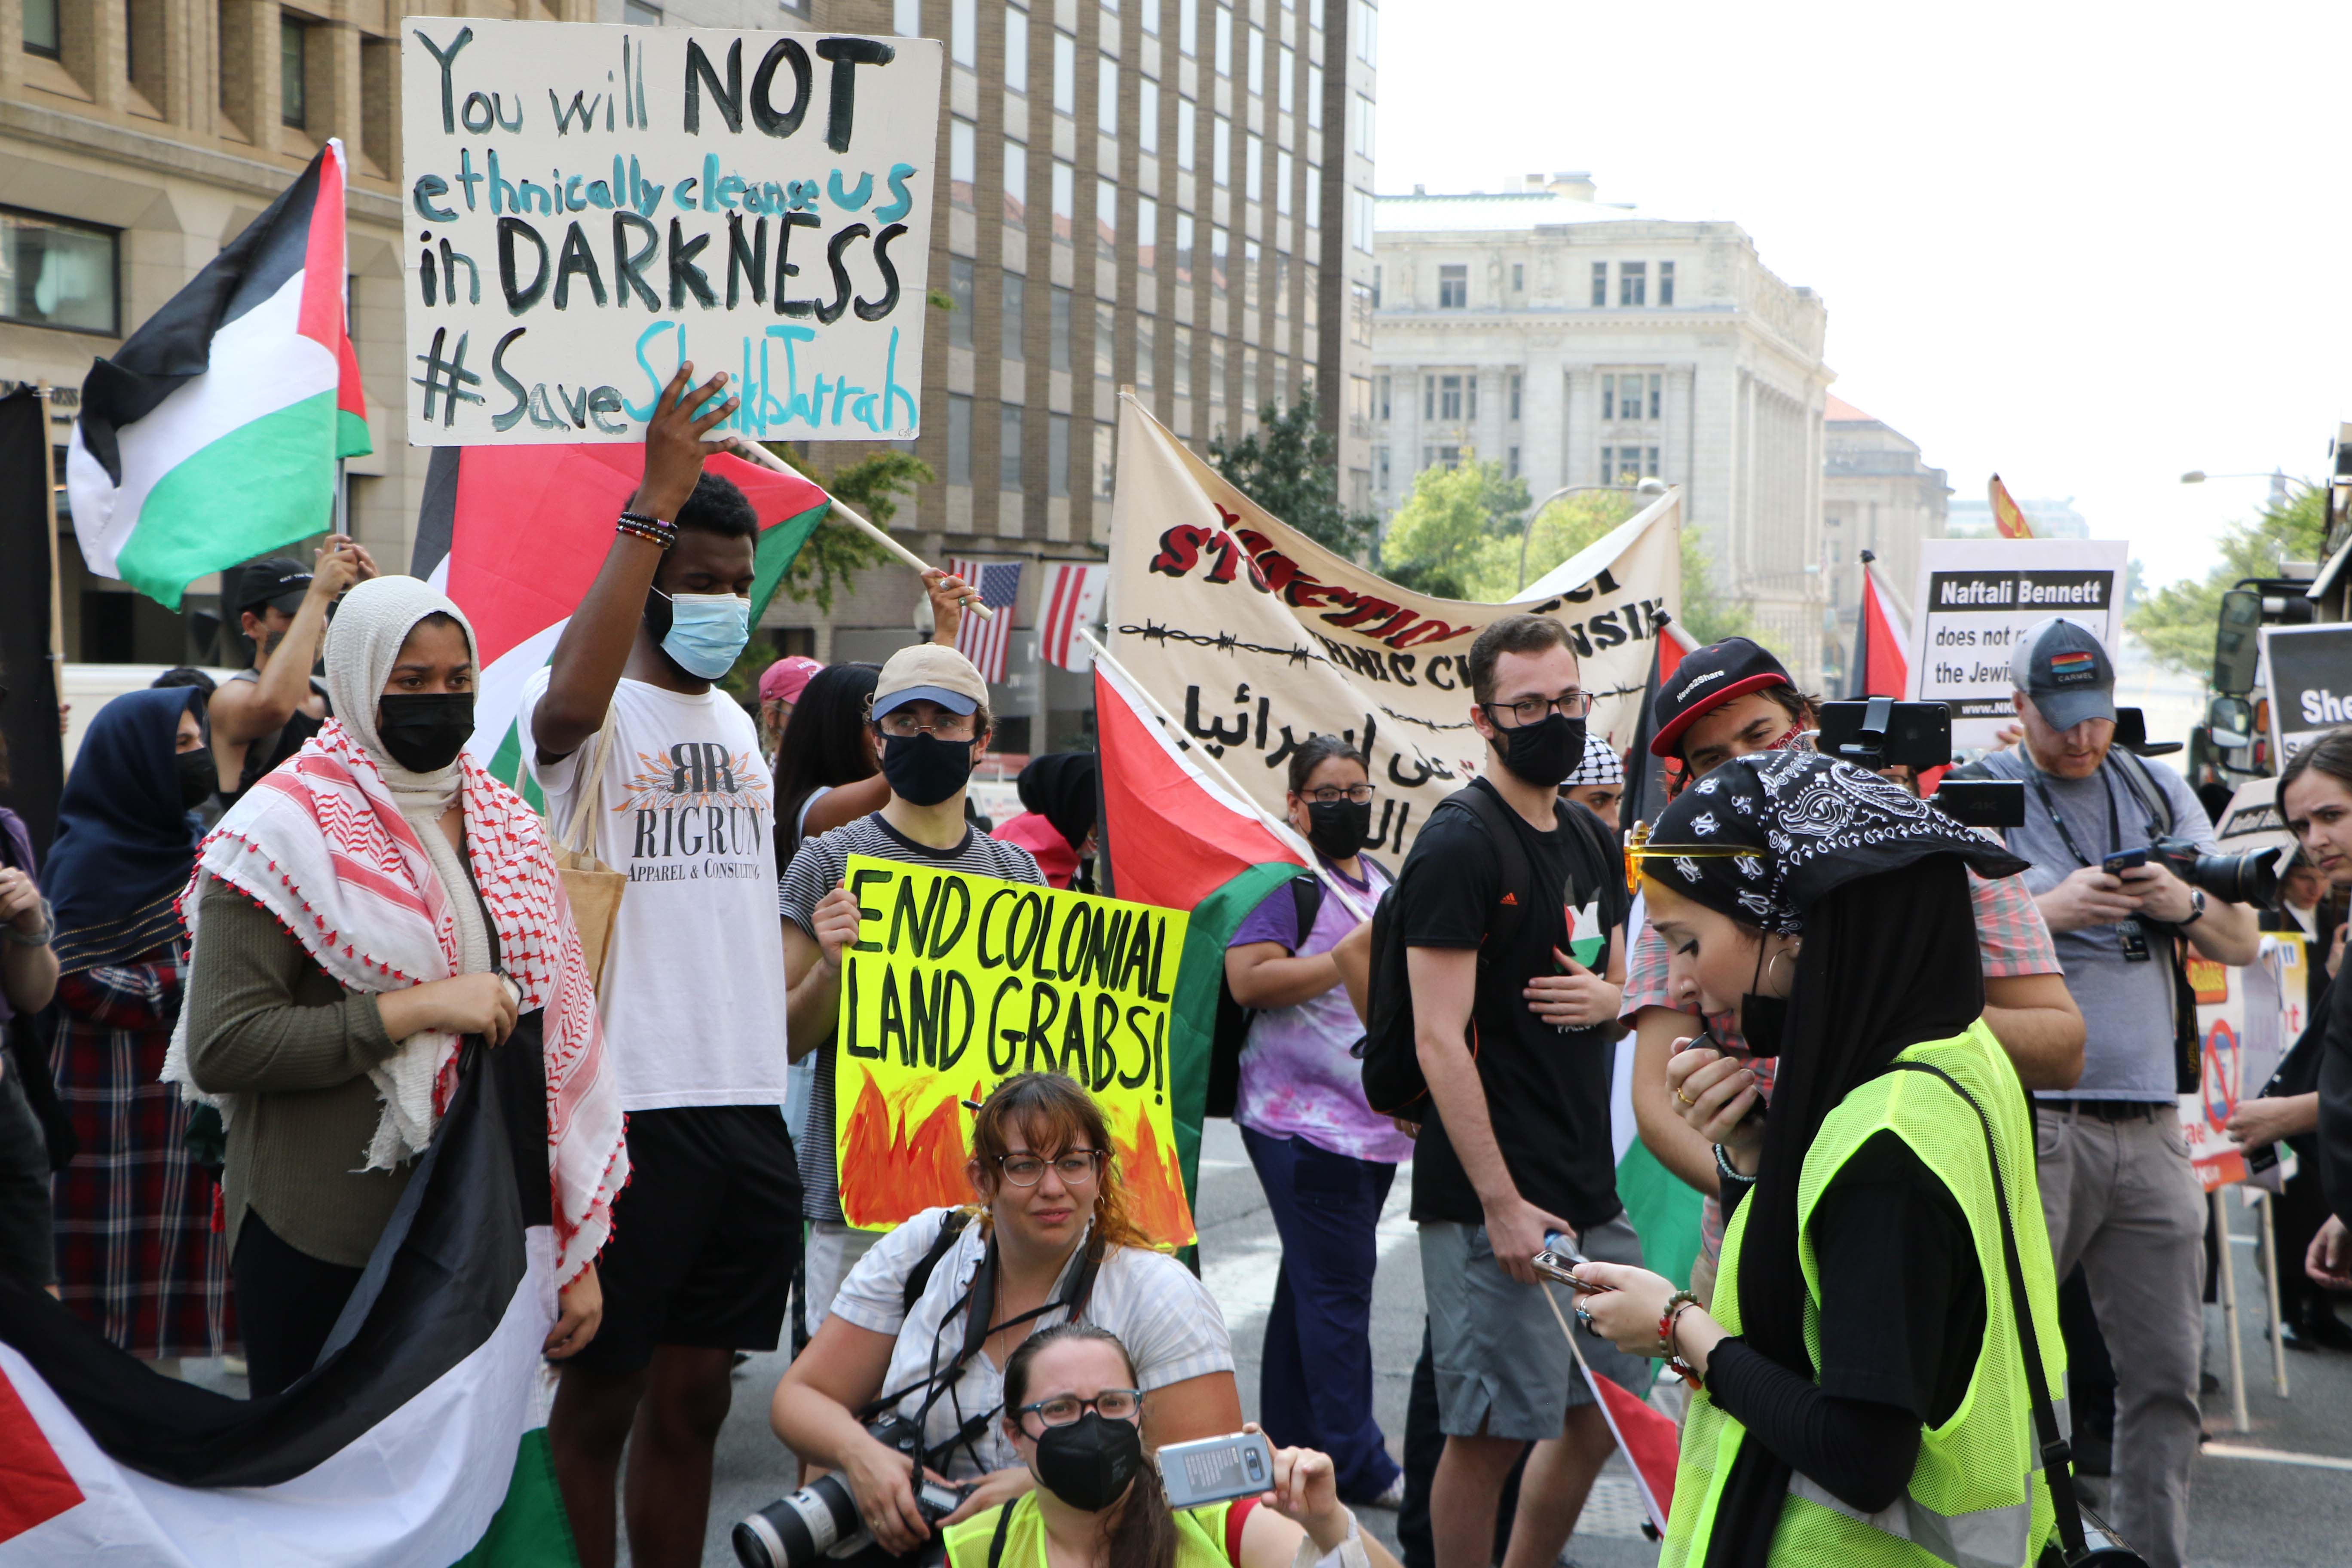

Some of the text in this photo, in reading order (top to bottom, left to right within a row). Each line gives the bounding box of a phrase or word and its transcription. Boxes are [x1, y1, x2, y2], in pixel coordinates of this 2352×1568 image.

[413, 26, 895, 155] You will NOT
[413, 147, 918, 224] ethnically cleanse us
[419, 210, 909, 325] in DARKNESS
[1940, 580, 2101, 605] Naftali Bennett
[1936, 626, 1975, 646] does
[1982, 625, 2010, 645] not
[1676, 670, 1725, 703] News2Share
[1936, 662, 1963, 684] the
[2057, 672, 2094, 682] CARMEL
[631, 805, 765, 859] RIGRUN
[690, 865, 699, 880] &
[850, 869, 1170, 1003] END COLONIAL
[847, 957, 1164, 1106] LAND GRABS!
